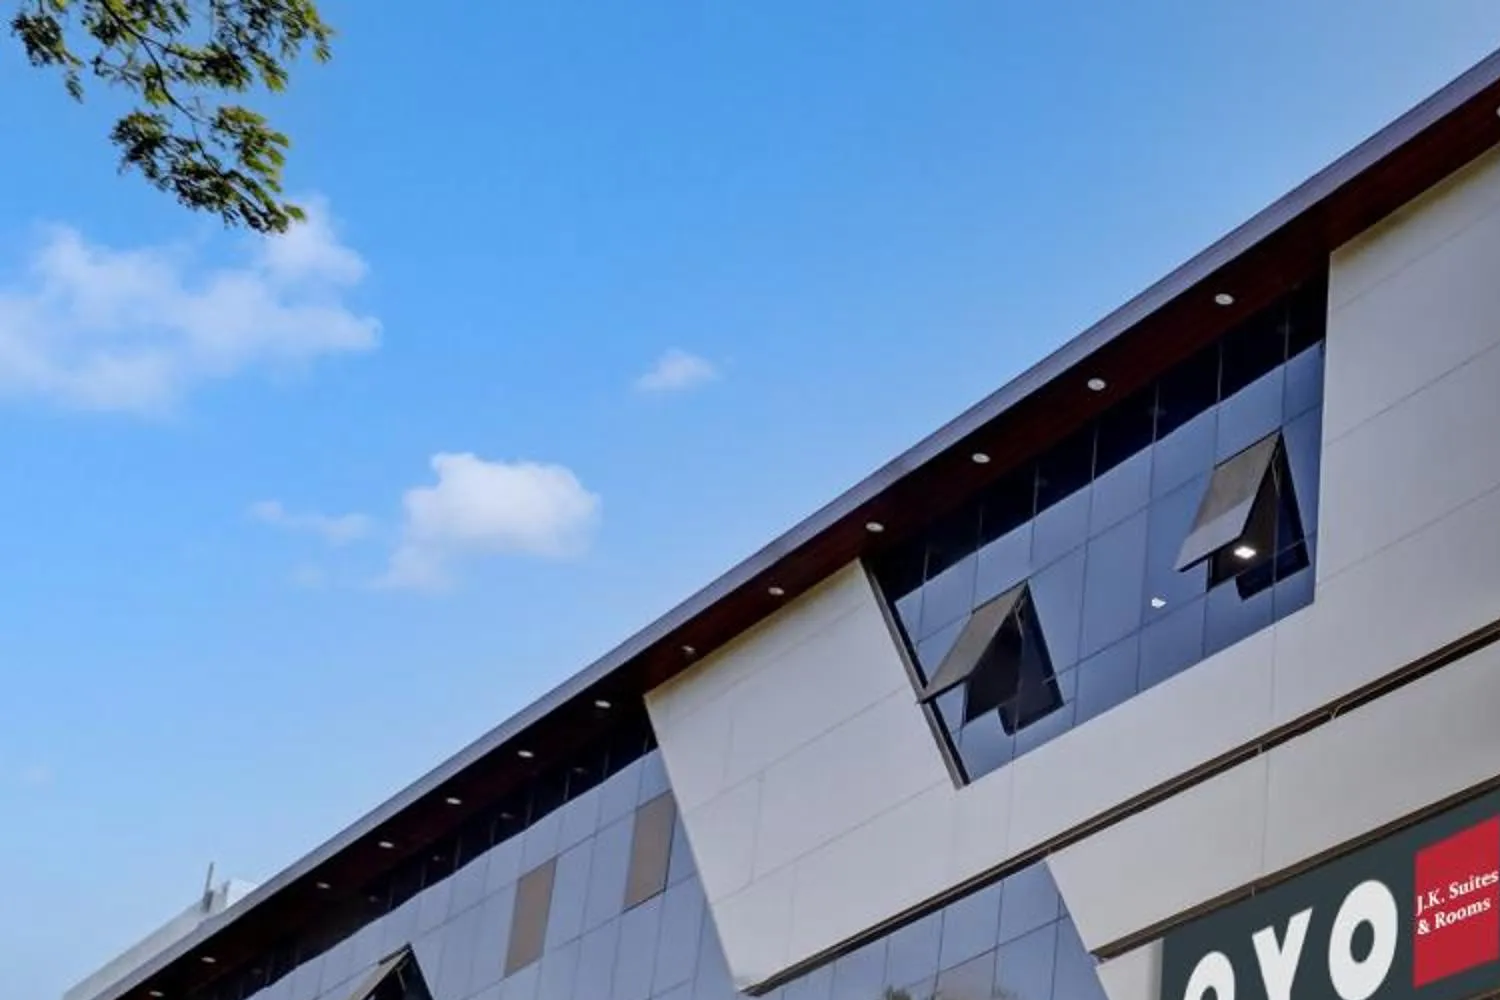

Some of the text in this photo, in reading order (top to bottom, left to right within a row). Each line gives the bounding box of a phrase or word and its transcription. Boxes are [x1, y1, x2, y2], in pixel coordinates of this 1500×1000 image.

[1415, 869, 1500, 916] J.K. Suites
[1416, 896, 1492, 936] & Rooms
